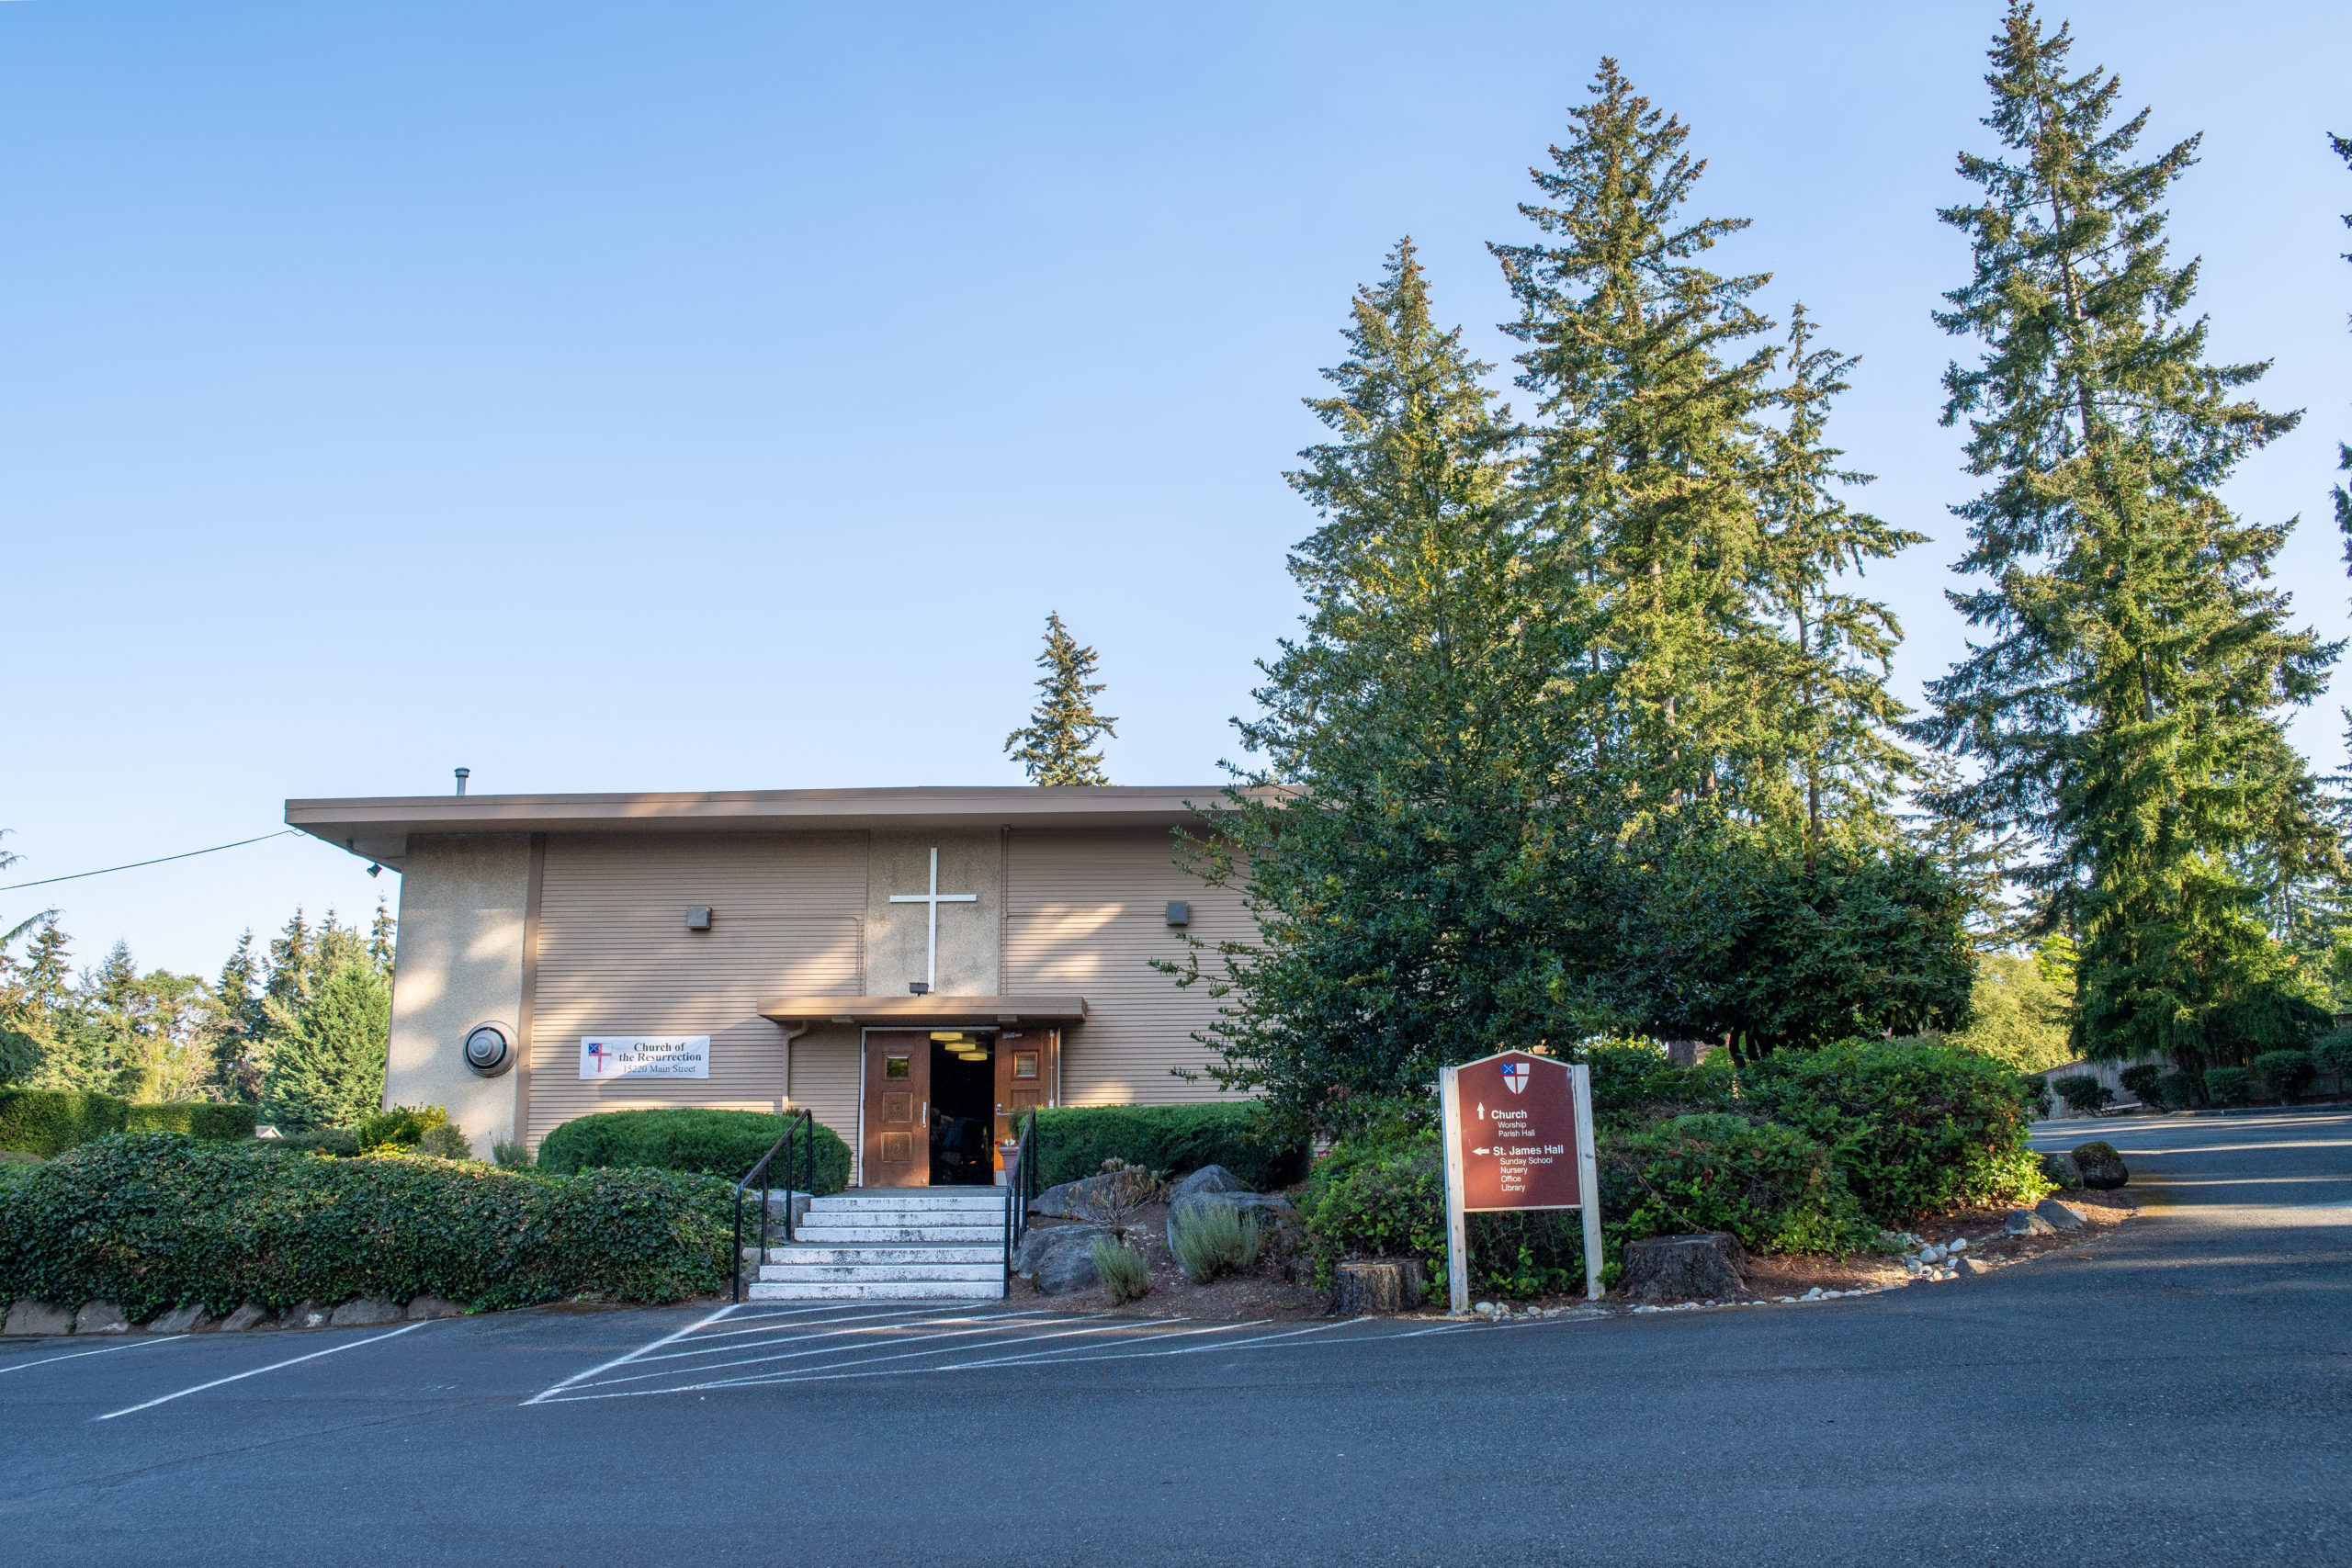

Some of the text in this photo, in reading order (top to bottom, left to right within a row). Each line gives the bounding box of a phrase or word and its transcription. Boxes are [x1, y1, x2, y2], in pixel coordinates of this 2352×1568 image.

[634, 1043, 686, 1052] Church of
[619, 1052, 702, 1062] the Resurrection
[624, 1065, 696, 1073] 15220 Main Street
[1491, 1110, 1528, 1120] Church
[1498, 1121, 1527, 1130] Worship
[1493, 1145, 1564, 1156] St. James Hall
[1499, 1157, 1527, 1166] Sunday
[1500, 1167, 1528, 1175] Nursery
[1500, 1175, 1521, 1183] Office
[1501, 1184, 1526, 1192] Library
